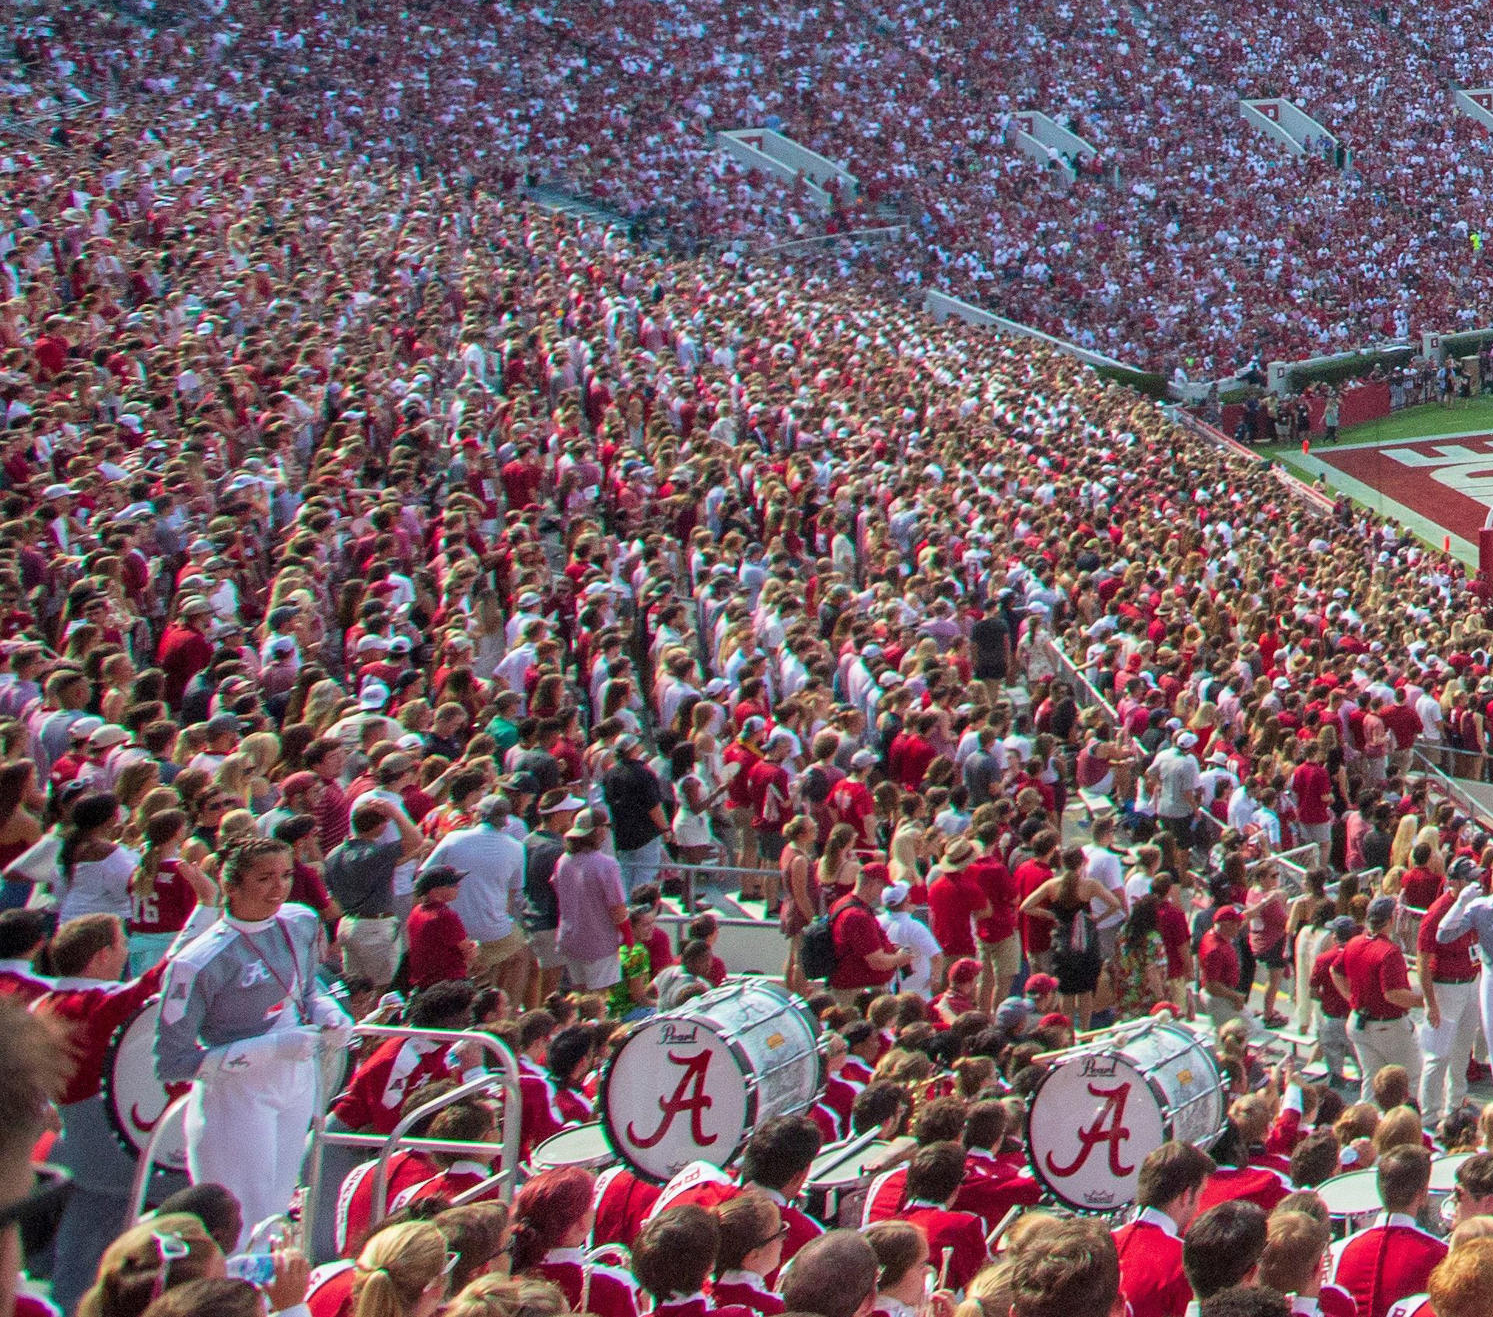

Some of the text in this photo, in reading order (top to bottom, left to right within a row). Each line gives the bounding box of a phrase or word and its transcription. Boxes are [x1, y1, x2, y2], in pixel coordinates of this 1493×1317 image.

[657, 1022, 699, 1045] Pearl
[1077, 1055, 1117, 1078] Pearl
[626, 1048, 719, 1150] A
[1046, 1081, 1135, 1178] A
